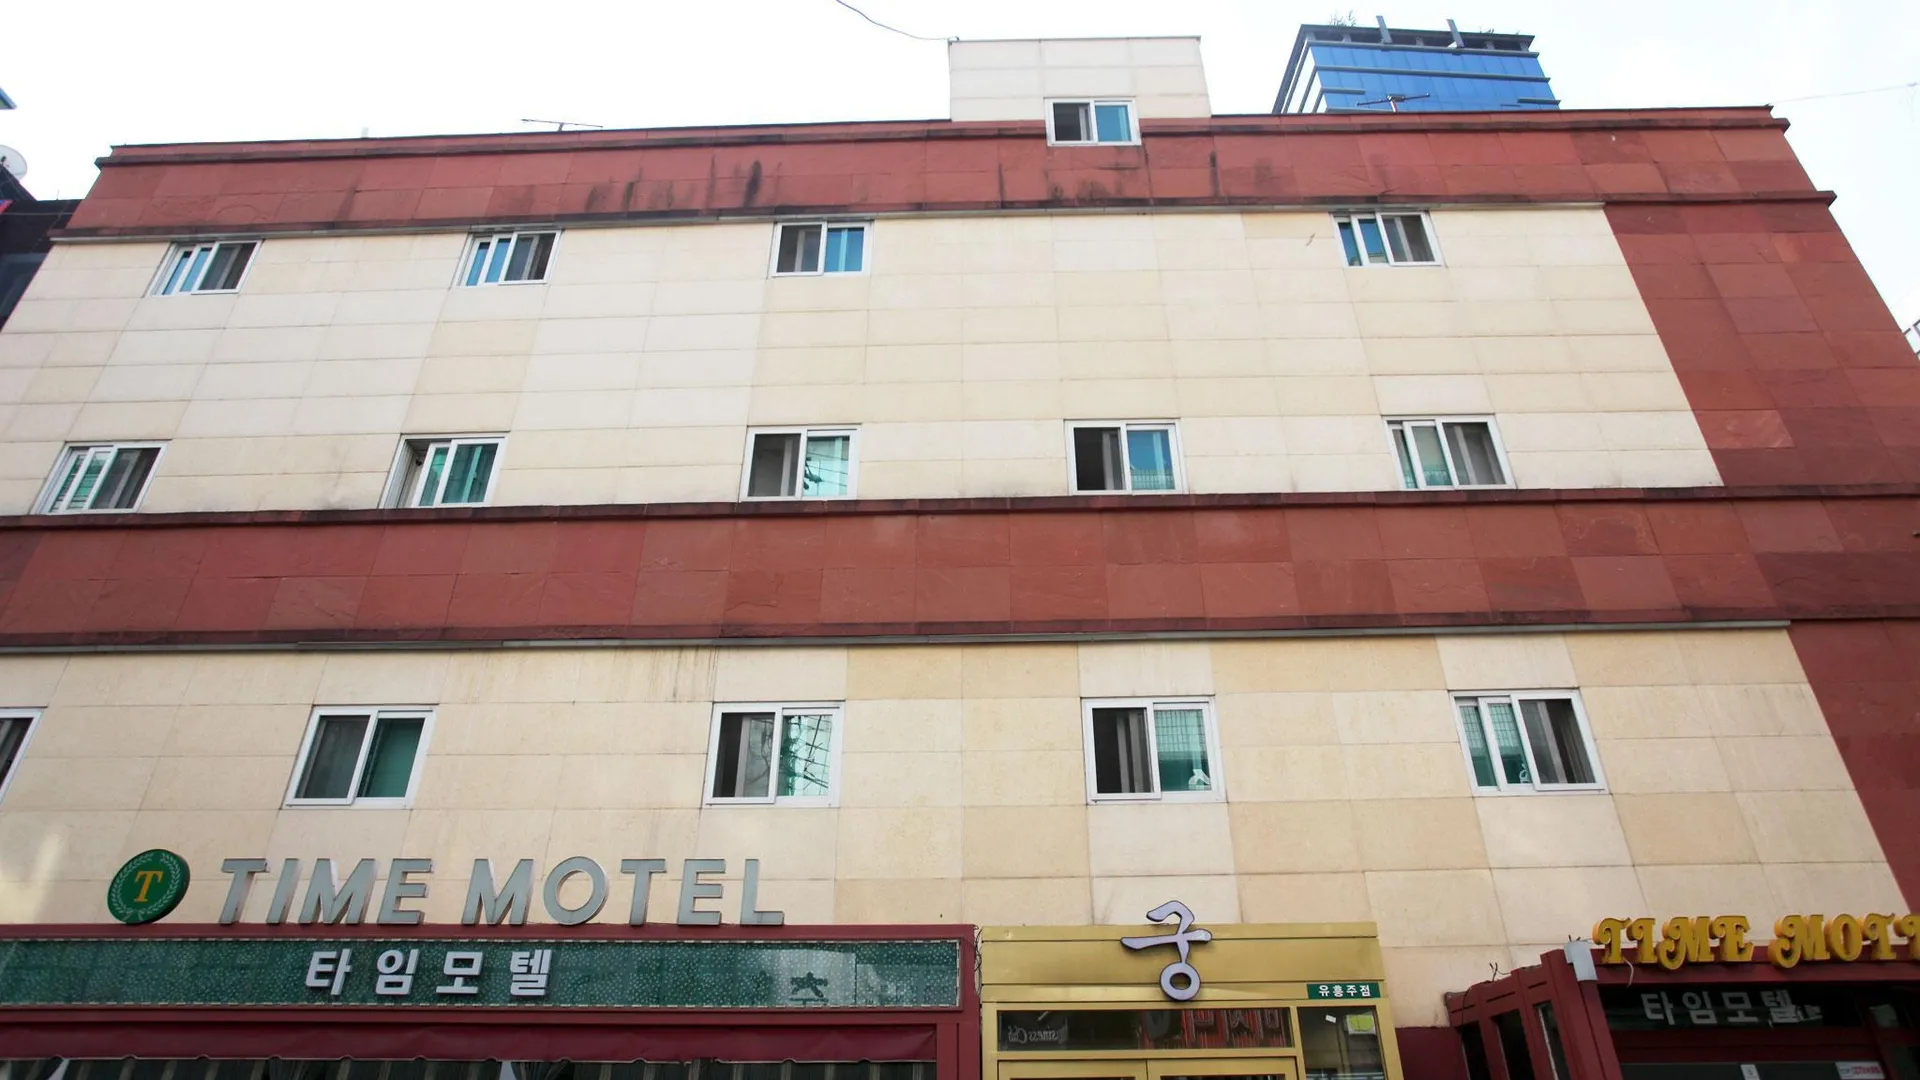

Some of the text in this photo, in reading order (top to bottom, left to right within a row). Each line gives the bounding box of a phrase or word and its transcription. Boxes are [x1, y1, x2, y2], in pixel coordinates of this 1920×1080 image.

[218, 856, 785, 927] TIME MOTEL
[1593, 916, 1753, 970] TIME
[304, 948, 552, 996] 타임모텔
[1318, 984, 1372, 998] 유흥주점
[1640, 989, 1802, 1025] 타임모텔
